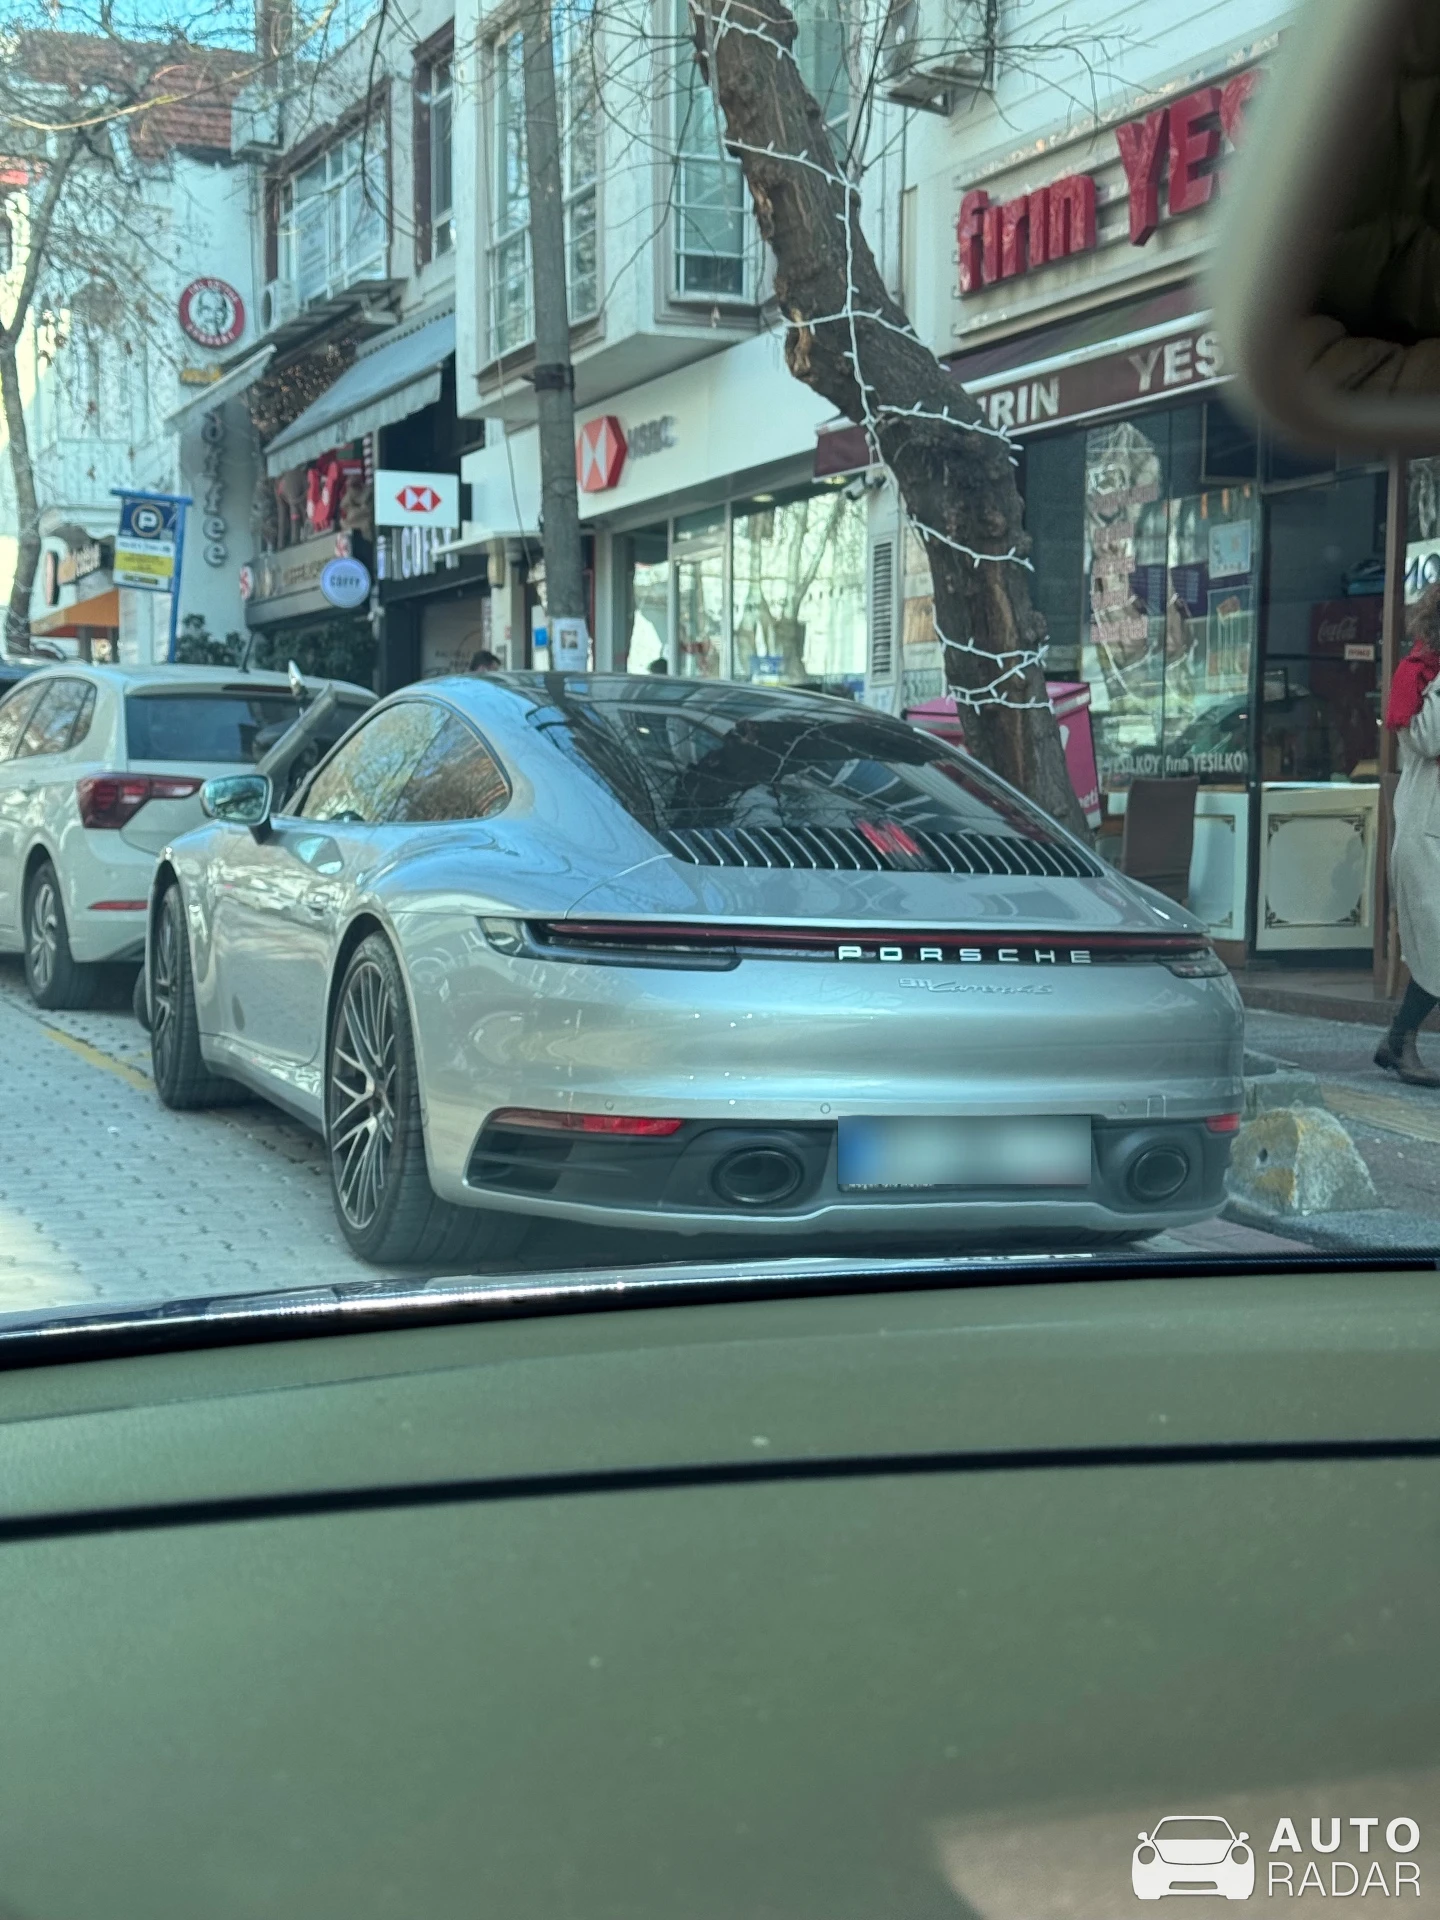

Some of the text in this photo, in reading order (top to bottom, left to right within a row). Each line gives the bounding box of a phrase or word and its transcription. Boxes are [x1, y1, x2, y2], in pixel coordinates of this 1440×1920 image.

[977, 376, 1059, 429] RIN
[330, 575, 361, 588] COFFY
[838, 946, 1092, 964] PORSCHE
